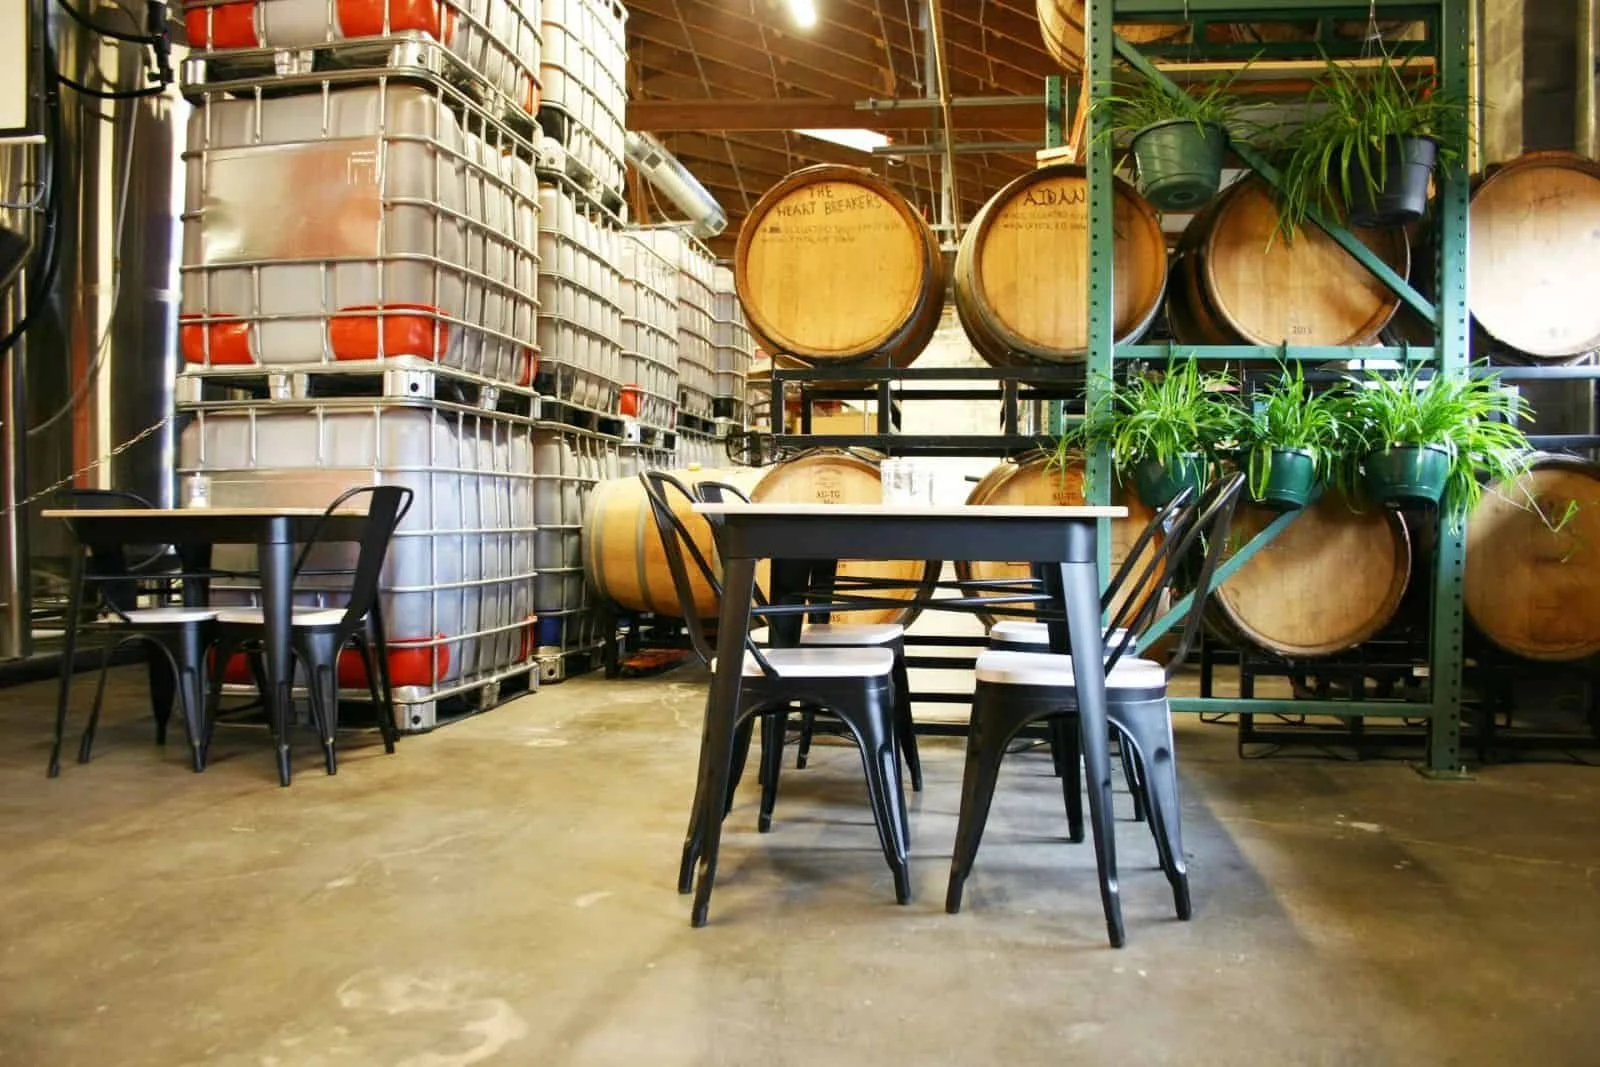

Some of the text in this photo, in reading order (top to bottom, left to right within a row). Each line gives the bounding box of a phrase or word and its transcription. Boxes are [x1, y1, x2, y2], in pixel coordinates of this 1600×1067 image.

[808, 185, 833, 199] THE
[1023, 188, 1085, 206] AIDAN
[776, 194, 883, 217] HEART BREAKERS
